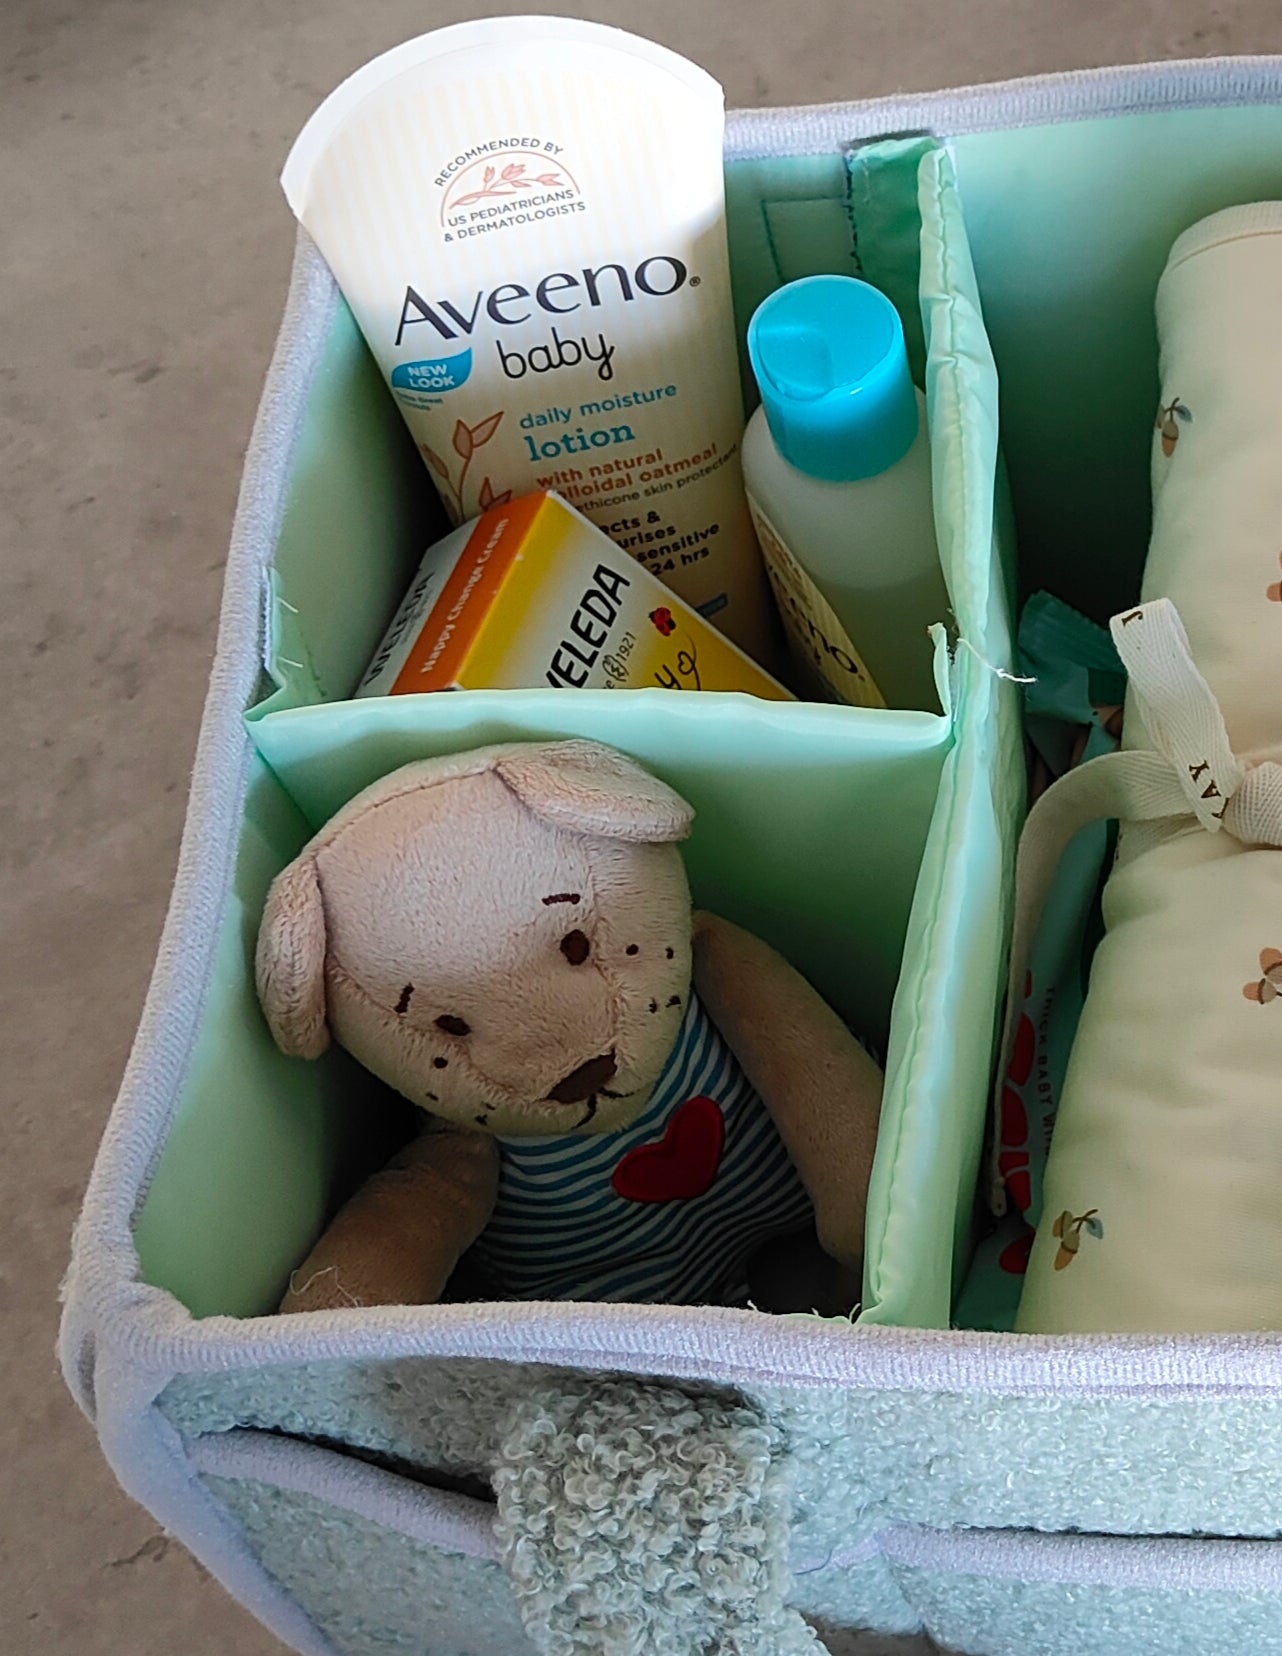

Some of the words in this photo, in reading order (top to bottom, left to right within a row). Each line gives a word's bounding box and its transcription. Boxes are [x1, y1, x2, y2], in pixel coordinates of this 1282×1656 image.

[434, 137, 540, 187] RECOMMENDED
[543, 142, 563, 155] BY
[444, 233, 454, 242] &
[457, 201, 586, 239] DERMATOLOGISTS
[448, 215, 467, 227] US
[470, 189, 574, 222] PEDIATRICIANS
[408, 364, 447, 377] NEW
[496, 326, 615, 380] baby
[409, 375, 455, 388] LOOK
[519, 407, 572, 429] daily
[579, 384, 677, 417] moisture
[523, 424, 635, 462] lotion
[536, 468, 583, 489] with
[589, 448, 663, 478] natural
[557, 473, 633, 500] olloidal
[639, 442, 718, 482] oatmeal
[644, 481, 673, 497] skin
[599, 516, 640, 535] ects
[647, 510, 661, 524] &
[617, 525, 676, 549] urises
[636, 523, 720, 563] sensitive
[651, 559, 675, 576] 24
[681, 547, 710, 566] hrs
[420, 624, 456, 673] Nappy
[447, 566, 485, 621] Change
[477, 518, 509, 563] Cream
[615, 632, 637, 661] 1921
